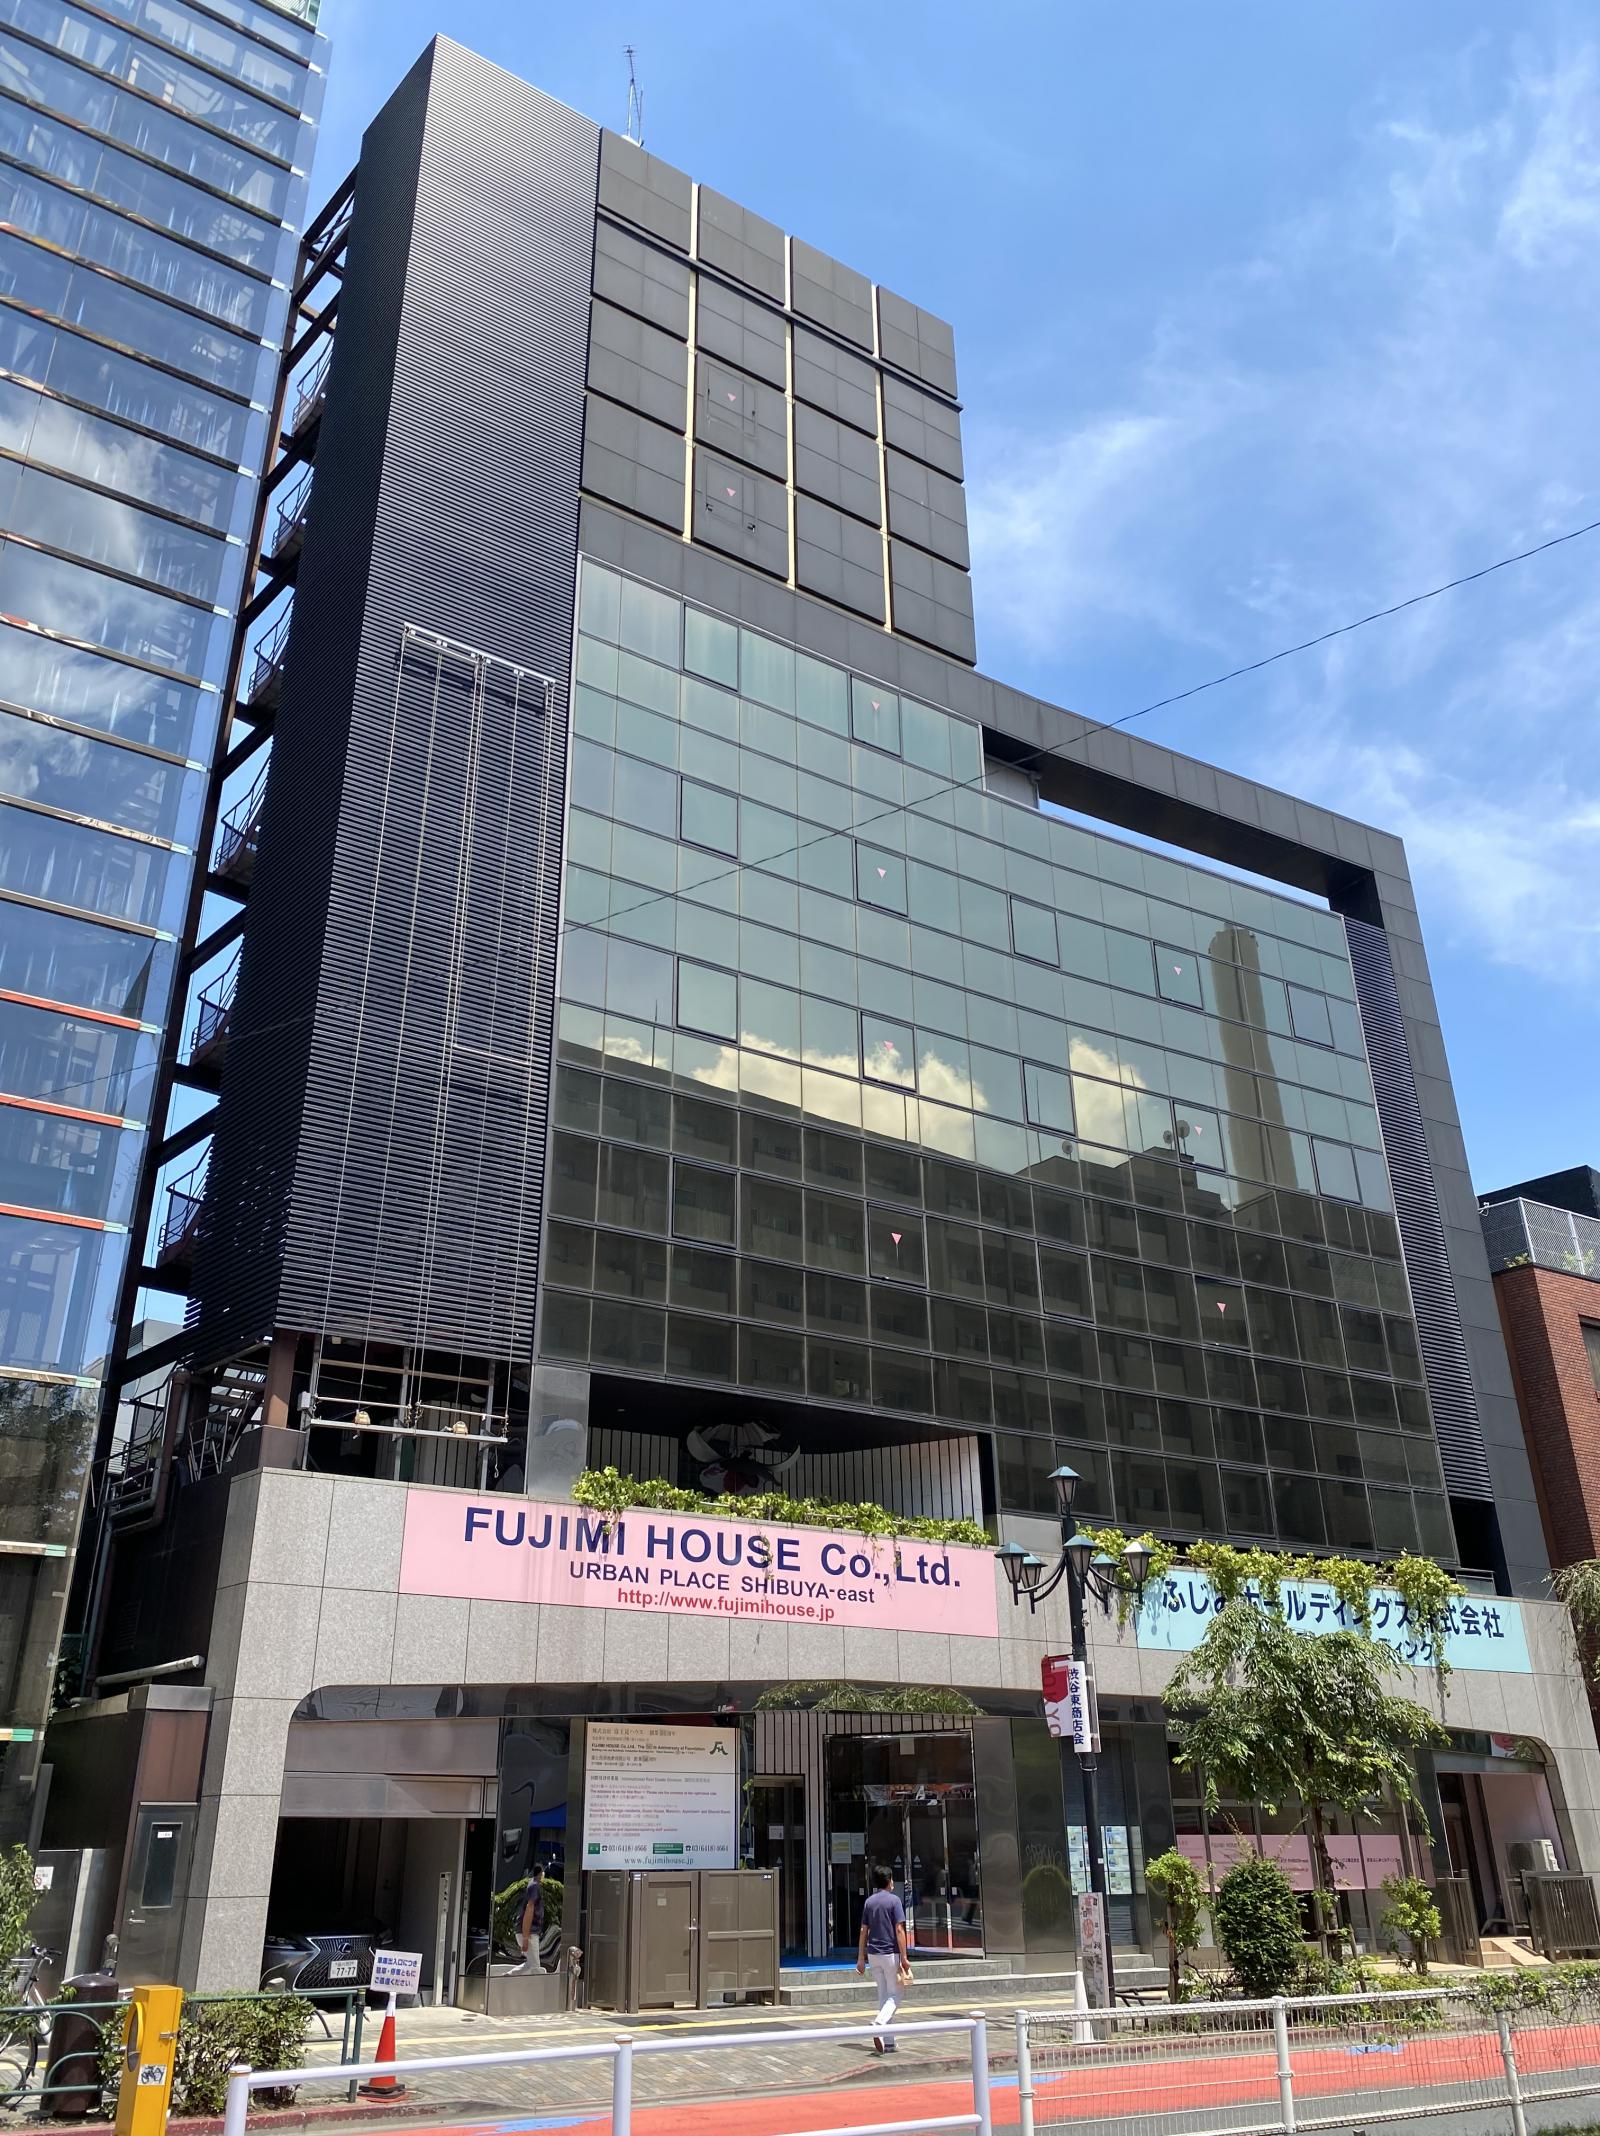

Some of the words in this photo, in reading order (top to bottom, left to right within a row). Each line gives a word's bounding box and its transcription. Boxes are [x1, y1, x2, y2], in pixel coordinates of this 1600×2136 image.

[463, 1506, 626, 1557] FUJIMI
[646, 1525, 802, 1573] HOUSE
[820, 1543, 962, 1589] Co.,Ltd.
[569, 1560, 649, 1585] URBAN
[659, 1569, 730, 1593] PLACE
[741, 1575, 875, 1604] SHIBUYA-east
[616, 1588, 835, 1622] http://www.fujimihouse.jp
[1068, 1667, 1085, 1745] 渋谷東商店会
